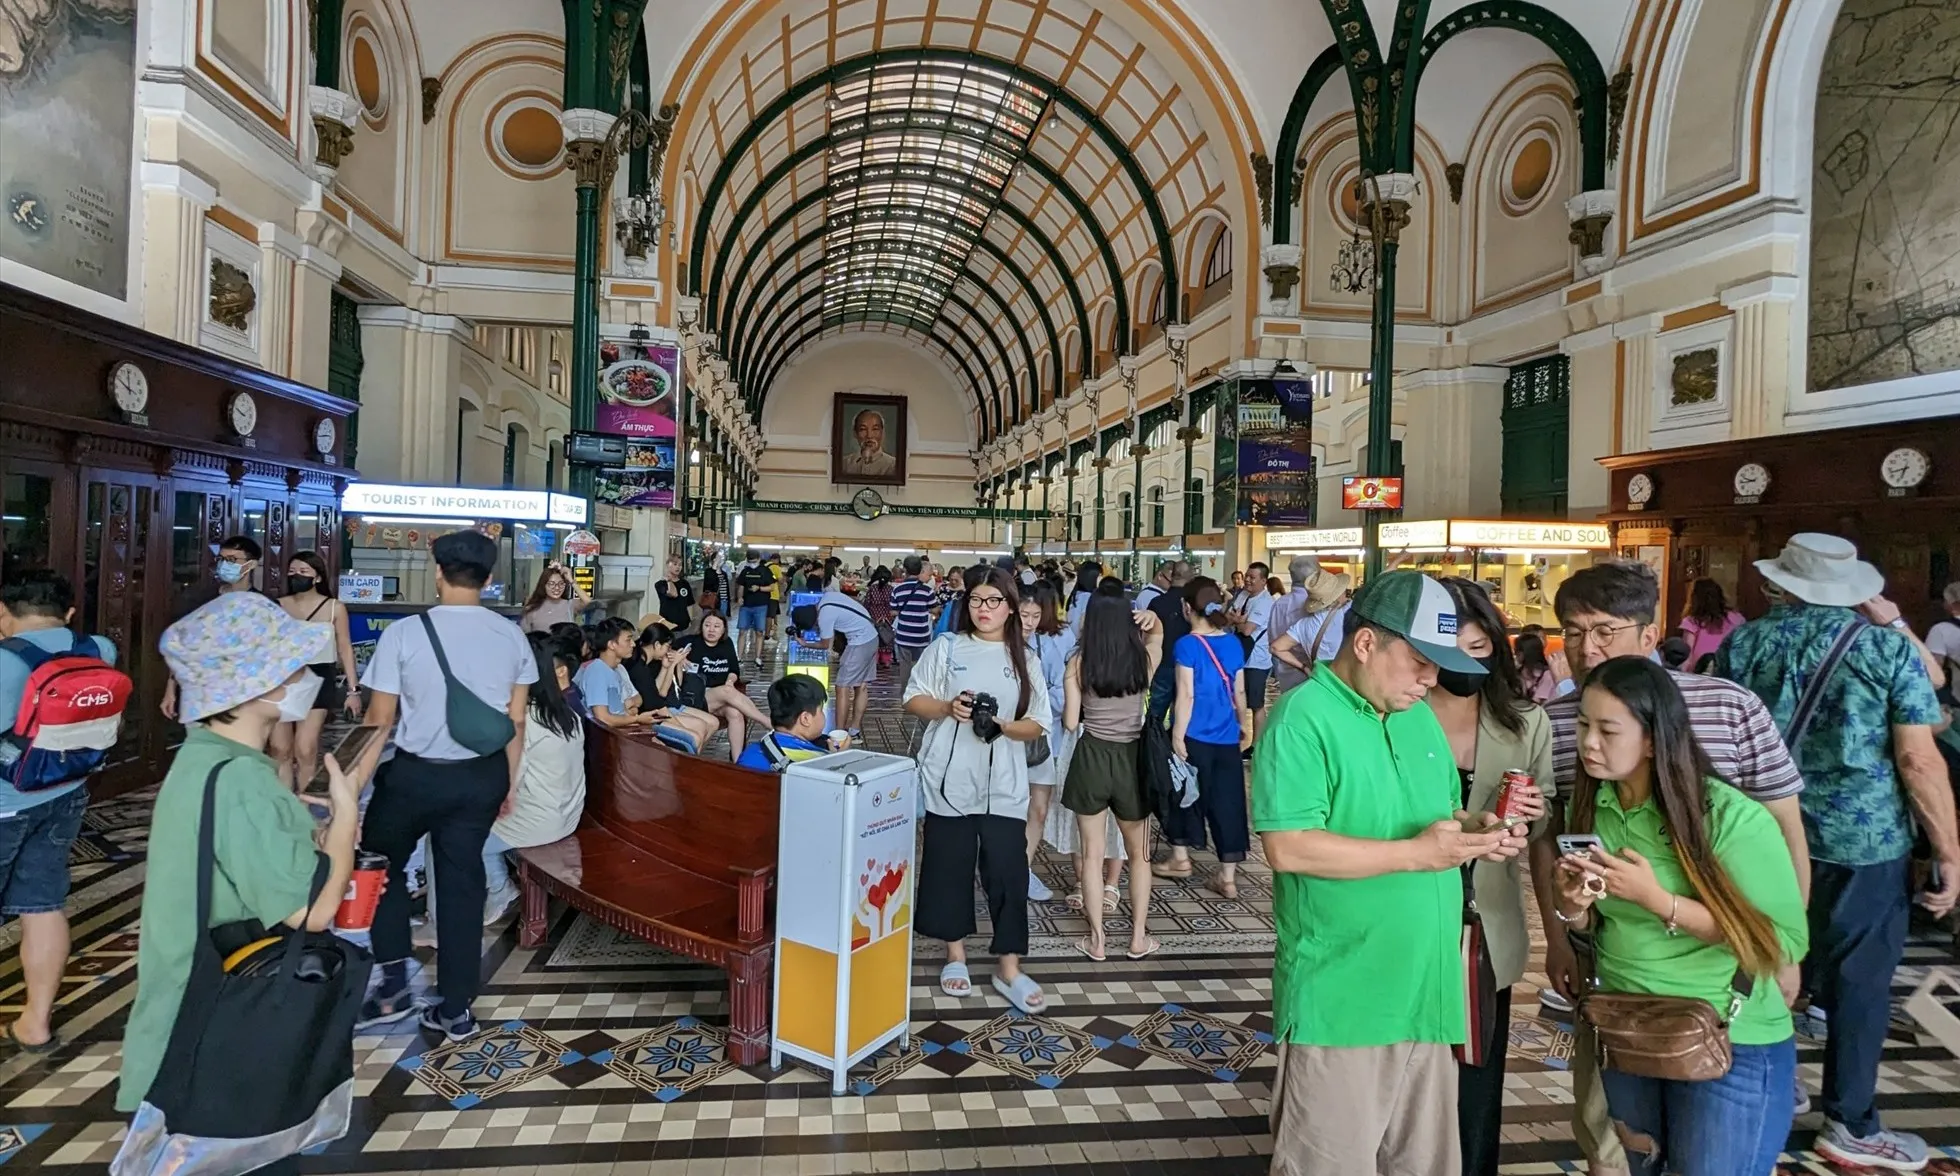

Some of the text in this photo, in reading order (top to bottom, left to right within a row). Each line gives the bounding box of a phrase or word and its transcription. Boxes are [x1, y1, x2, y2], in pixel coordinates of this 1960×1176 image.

[634, 424, 654, 432] THỰC
[361, 493, 427, 505] TOURIST
[431, 496, 539, 510] INFORMATION
[1270, 535, 1283, 544] BEST
[1319, 533, 1331, 543] THE
[1333, 532, 1357, 542] WORLD
[1381, 526, 1409, 538] Coffee
[1476, 527, 1537, 541] COFFEE
[1542, 529, 1573, 542] AND
[339, 578, 380, 587] SIM CARD
[77, 693, 109, 707] CMS
